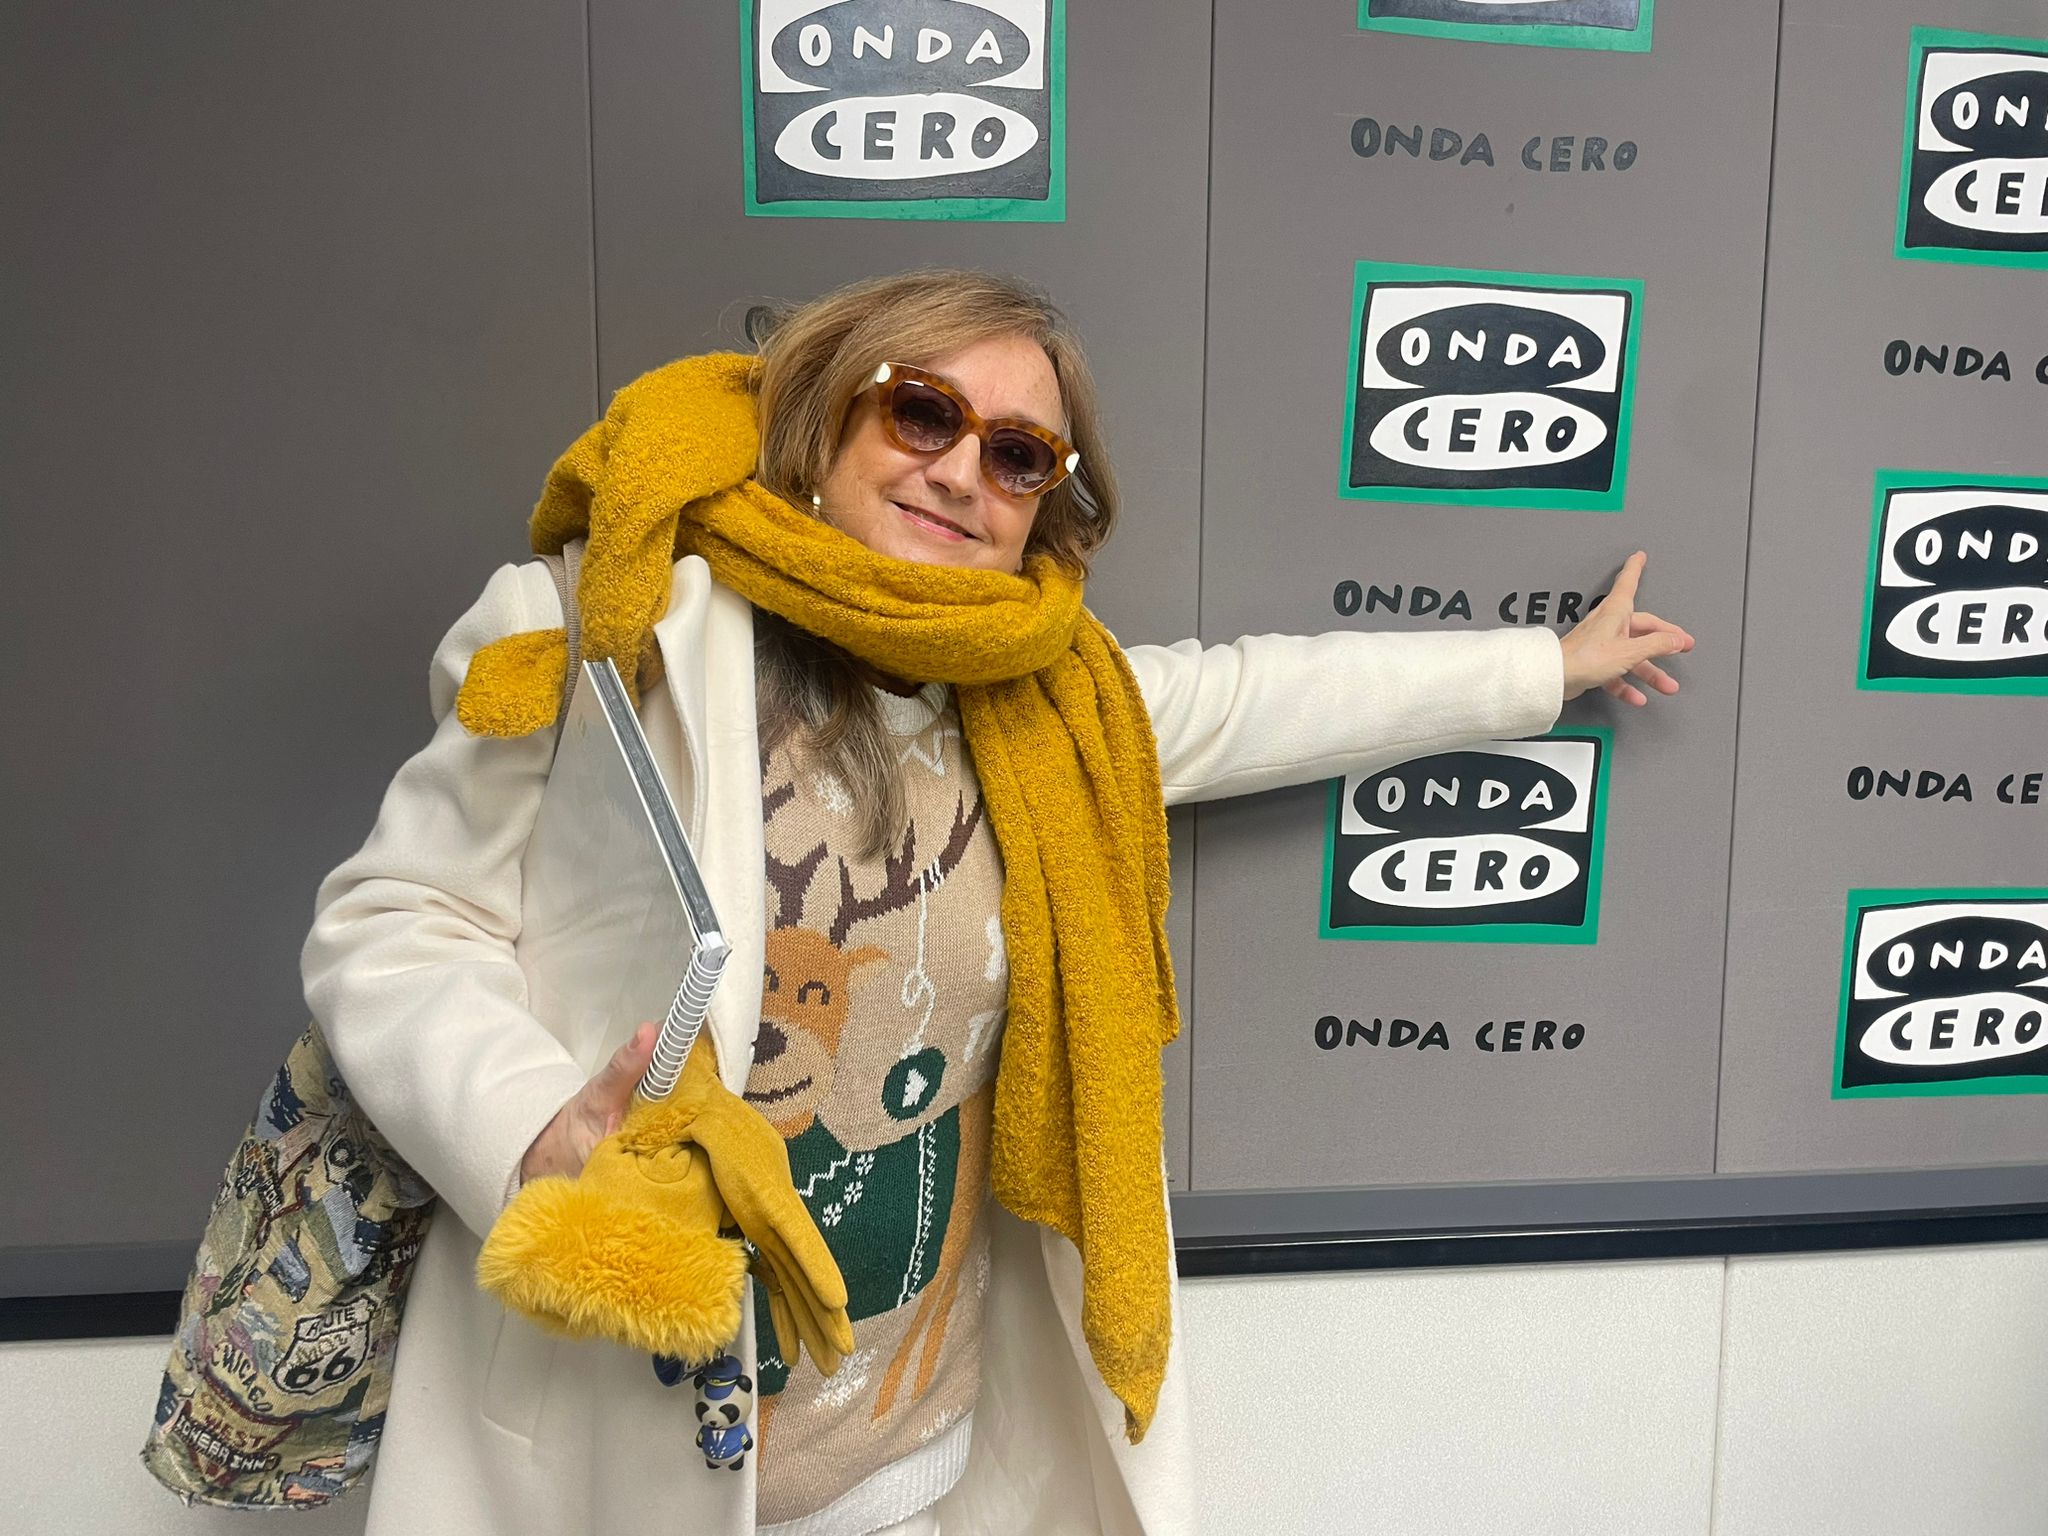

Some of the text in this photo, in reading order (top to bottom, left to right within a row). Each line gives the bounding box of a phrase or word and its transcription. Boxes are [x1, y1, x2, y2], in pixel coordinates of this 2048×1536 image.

[798, 23, 1004, 66] ONDA
[1952, 91, 2048, 131] ON
[811, 110, 1007, 160] CERO
[1351, 117, 1638, 172] ONDA CERO
[1955, 169, 2048, 217] CE
[1400, 327, 1582, 369] ONDA
[1884, 339, 2011, 382] ONDA
[1403, 406, 1577, 453] CERO
[1915, 529, 2048, 566] OND
[1333, 580, 1472, 621] ONDA
[1917, 602, 2048, 645] CER
[1377, 777, 1554, 813] ONDA
[1848, 766, 1973, 802] ONDA
[1381, 849, 1551, 892] CERO
[1887, 940, 2047, 977] ONDA
[1314, 1016, 1586, 1052] ONDA CERO
[1890, 1008, 2042, 1051] CERO
[283, 1346, 356, 1389] 66
